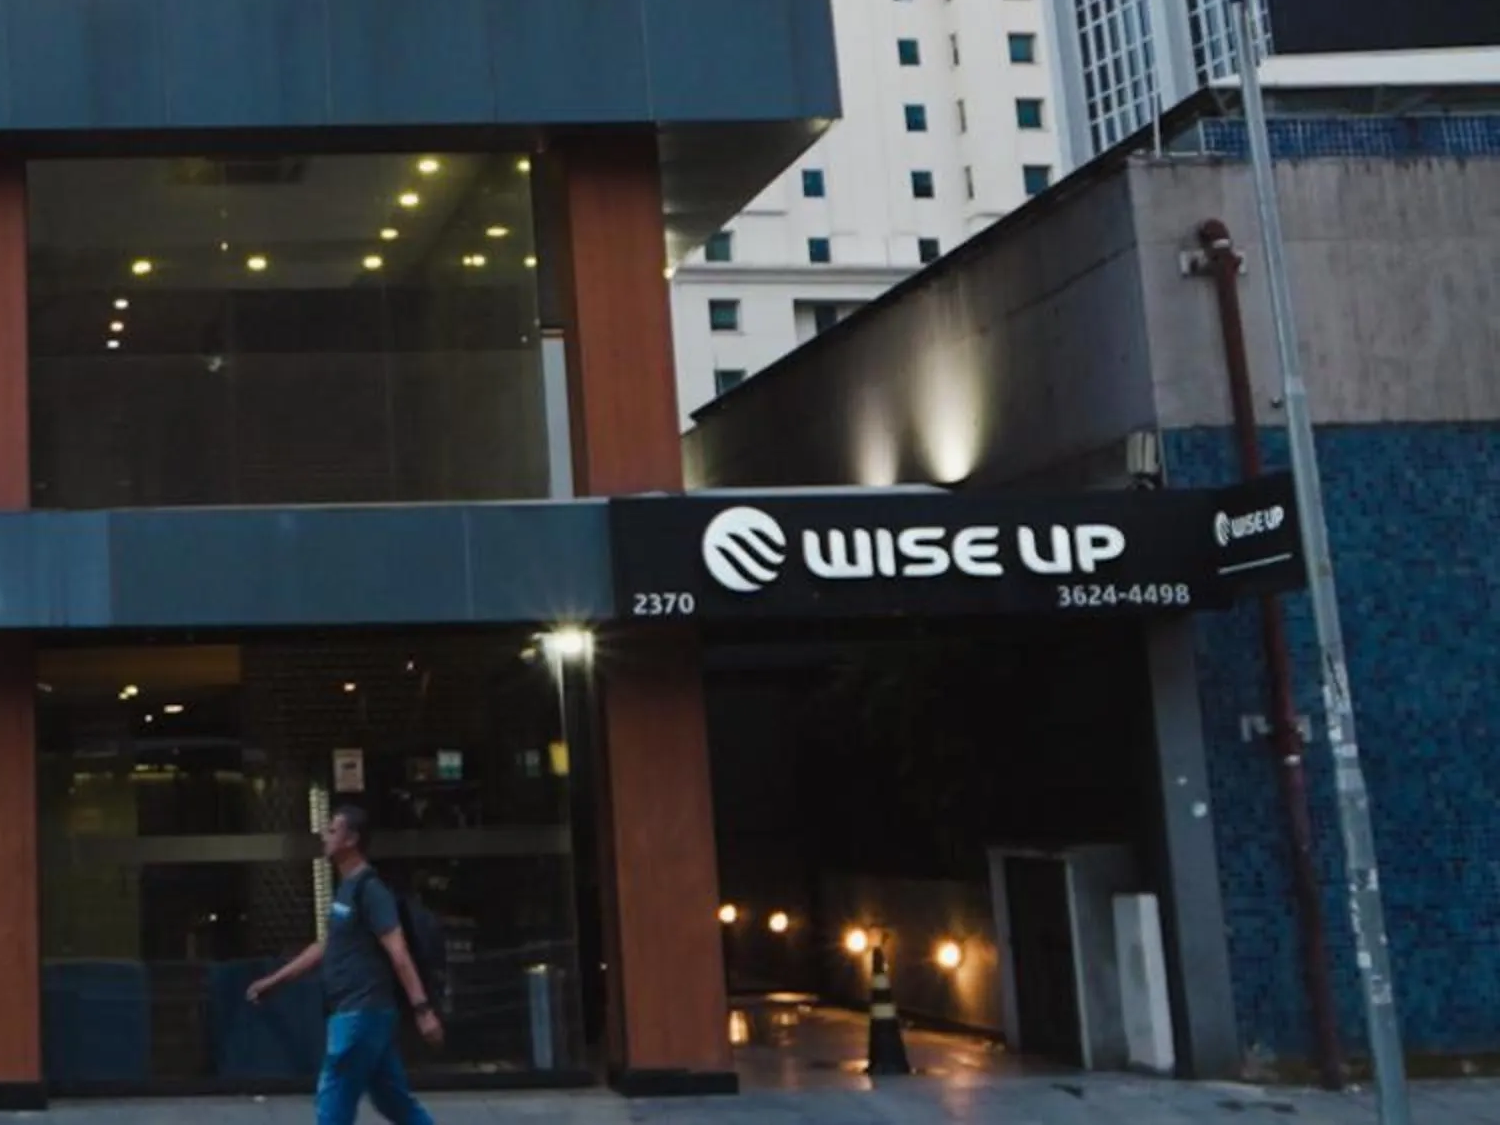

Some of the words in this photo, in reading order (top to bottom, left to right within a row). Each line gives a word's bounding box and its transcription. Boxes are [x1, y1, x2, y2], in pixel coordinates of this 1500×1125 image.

[803, 527, 1003, 578] WISE
[1017, 525, 1126, 573] UP
[633, 592, 695, 615] 2370
[1057, 583, 1191, 607] 3624-4498
